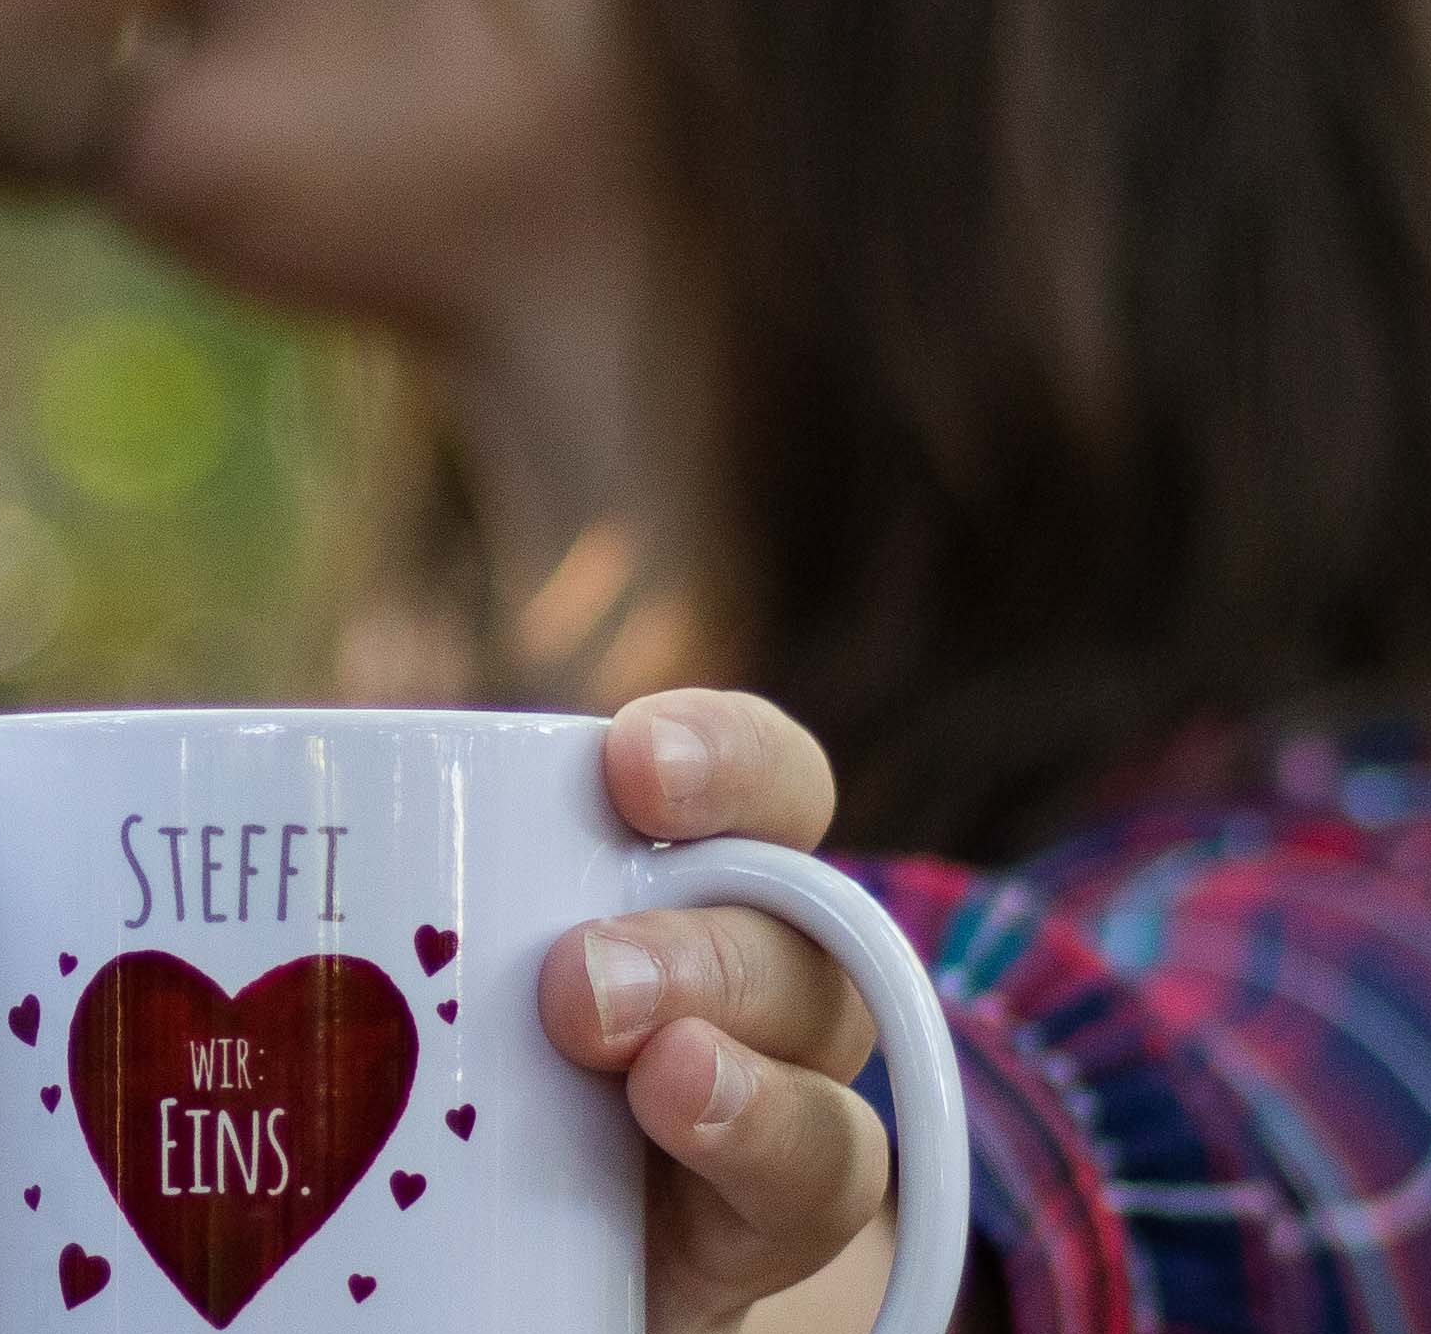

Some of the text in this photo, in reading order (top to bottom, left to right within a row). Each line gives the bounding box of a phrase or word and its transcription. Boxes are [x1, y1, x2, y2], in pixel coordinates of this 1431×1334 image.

[119, 814, 349, 930] STEFFI
[189, 1038, 266, 1093] WIR:
[159, 1097, 312, 1197] EINS.
